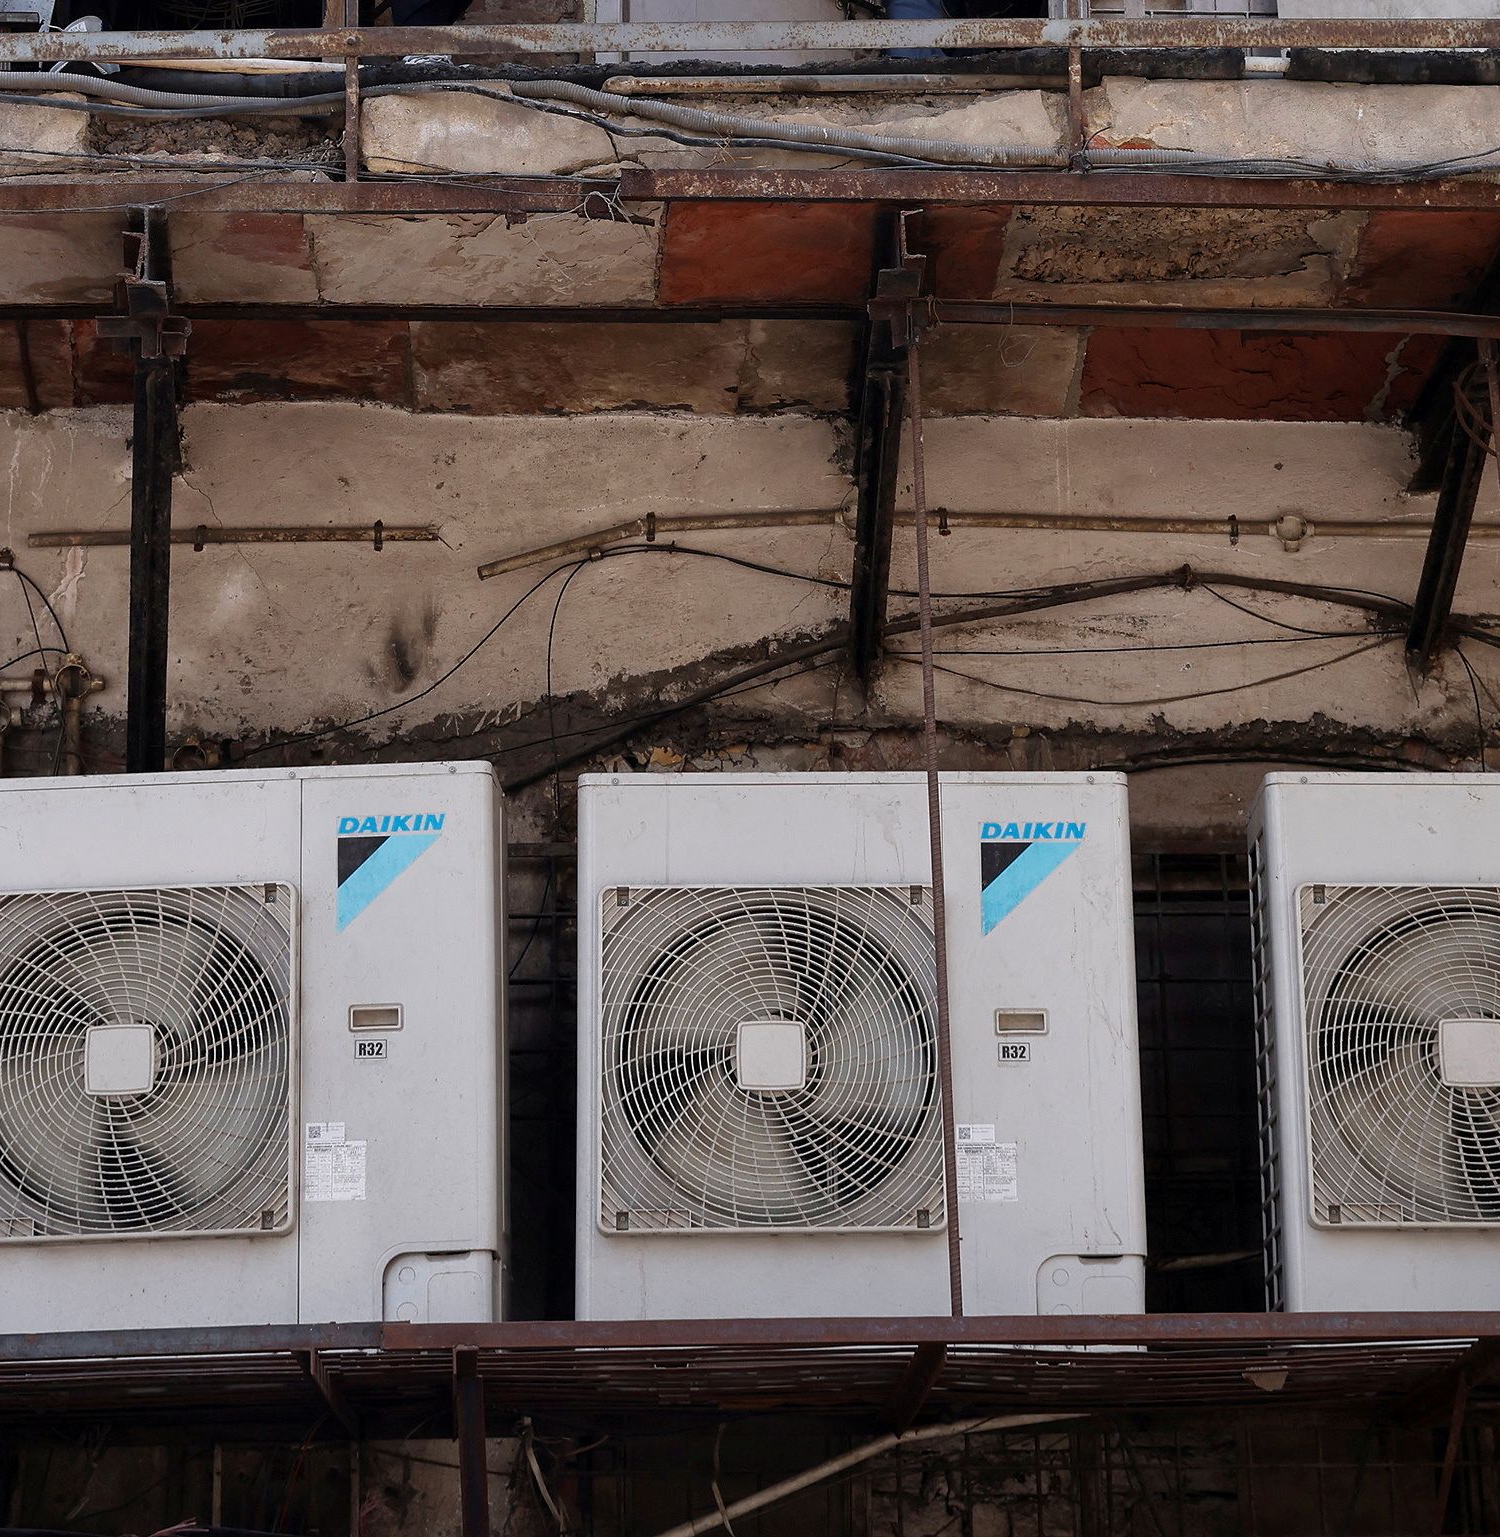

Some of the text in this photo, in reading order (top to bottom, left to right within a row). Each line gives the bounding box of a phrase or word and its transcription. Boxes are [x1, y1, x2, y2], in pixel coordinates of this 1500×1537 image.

[337, 812, 447, 835] DAIKIN
[980, 821, 1087, 840] DAIKIN
[357, 1041, 384, 1058] R32
[1001, 1044, 1028, 1061] R32
